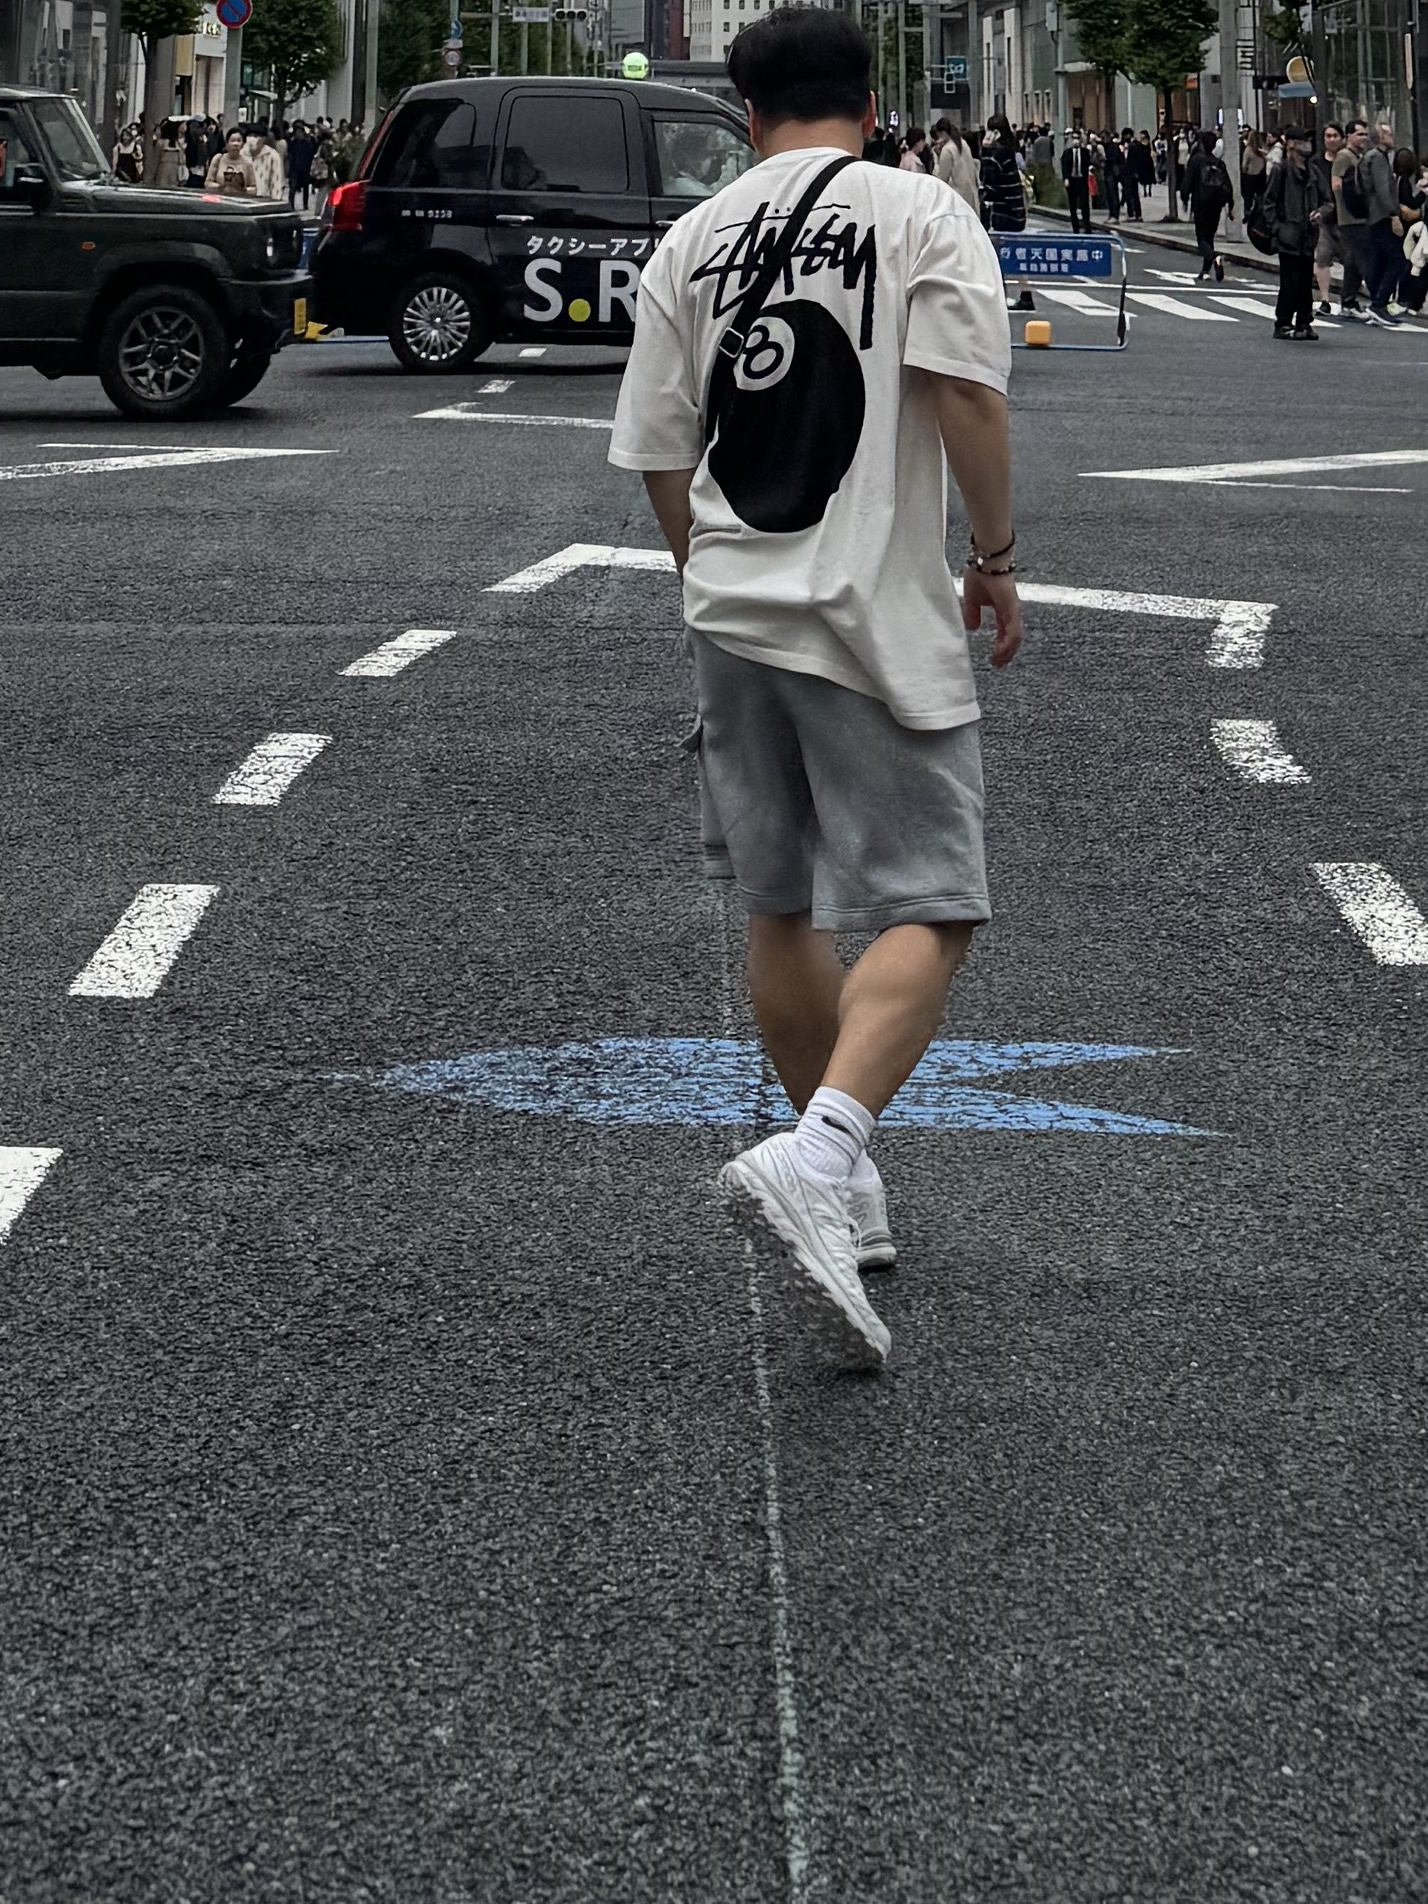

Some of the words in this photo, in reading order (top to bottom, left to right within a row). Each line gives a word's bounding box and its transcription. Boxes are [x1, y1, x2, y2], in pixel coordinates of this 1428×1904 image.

[526, 235, 661, 257] タクシーアプ
